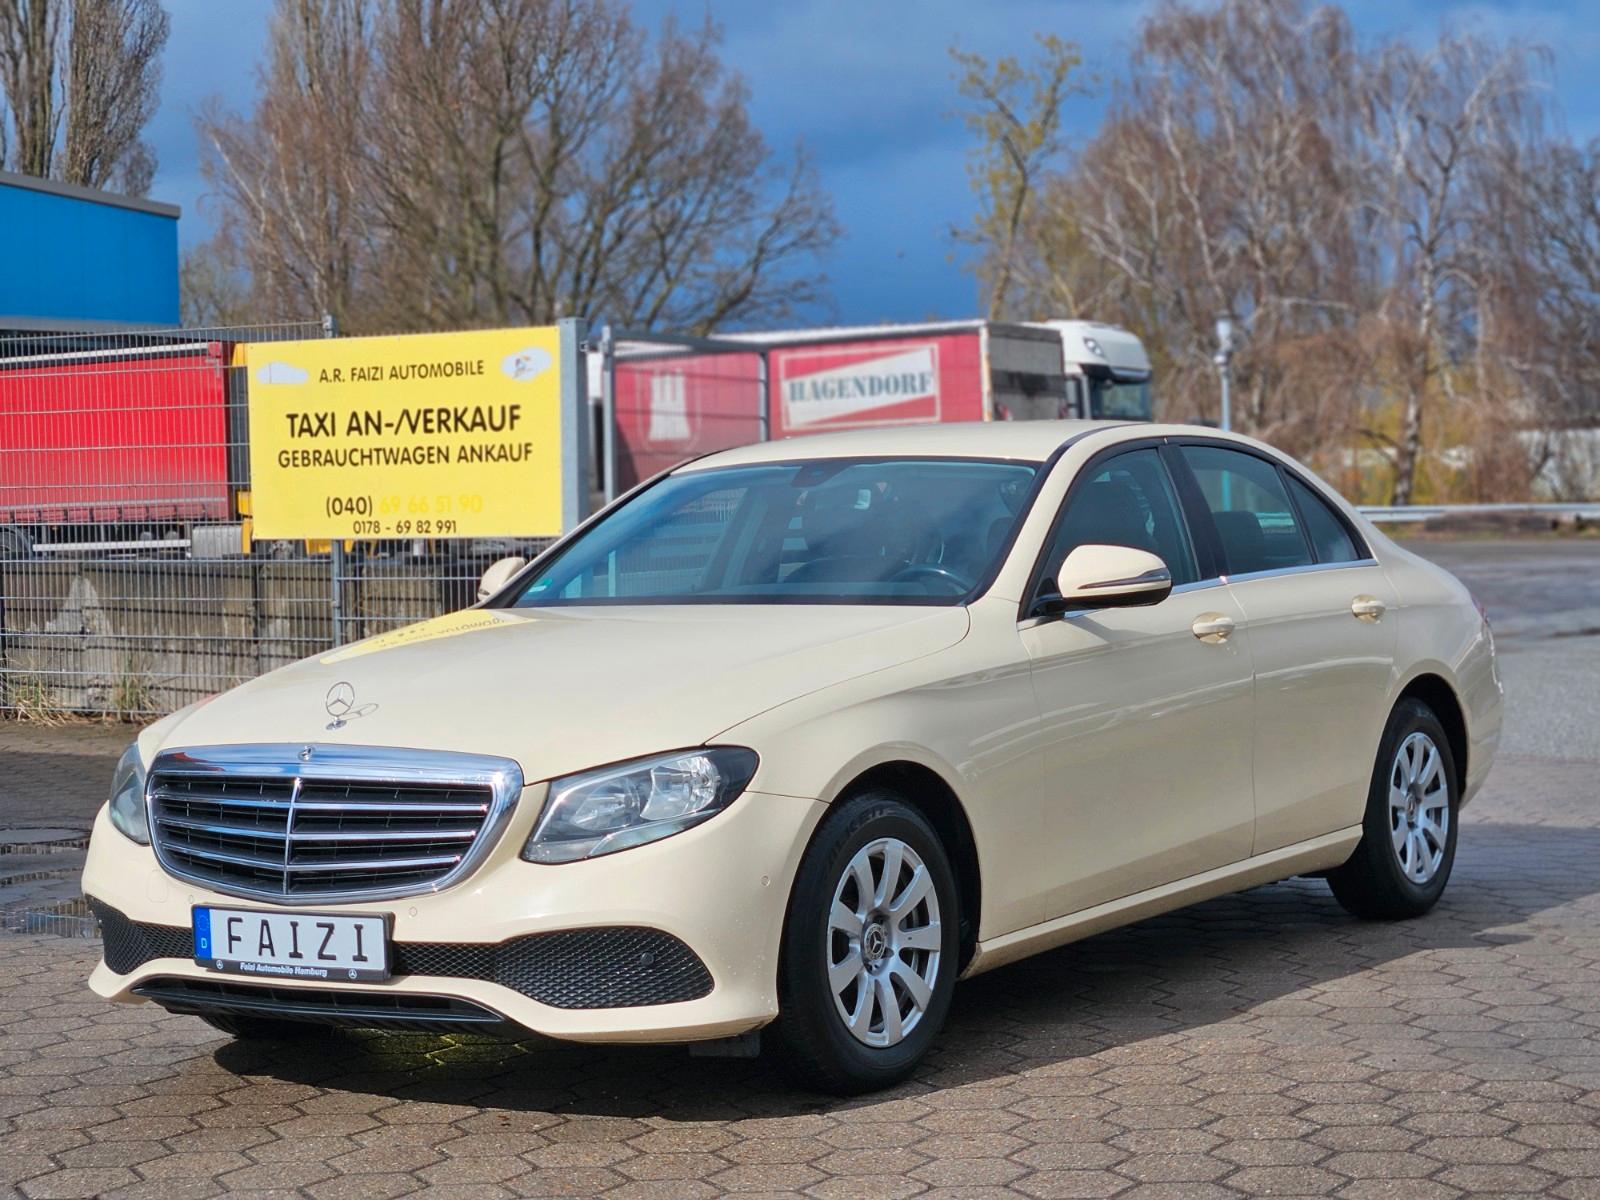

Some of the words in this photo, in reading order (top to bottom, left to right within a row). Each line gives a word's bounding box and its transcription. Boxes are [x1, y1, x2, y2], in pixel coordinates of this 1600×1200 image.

[319, 368, 346, 383] A.R.
[350, 366, 384, 382] FAIZI
[389, 360, 485, 381] AUTOMOBILE
[788, 371, 932, 403] HAGENDORF
[286, 411, 336, 439] TAXI
[346, 404, 521, 436] AN-/VERKAUF
[278, 445, 450, 469] GEBRAUCHTWAGEN
[457, 442, 533, 465] ANKAUF
[326, 495, 373, 518] (040)
[379, 496, 401, 514] 69
[407, 496, 430, 513] 66
[457, 495, 484, 513] 90
[353, 520, 381, 535] 0178
[396, 520, 412, 535] 69
[416, 520, 432, 534] 82
[436, 519, 458, 535] 991
[201, 937, 208, 949] D
[227, 916, 369, 963] FAIZI
[240, 962, 256, 972] Faizi
[256, 963, 294, 975] Automobile
[294, 966, 328, 978] Hamburg
